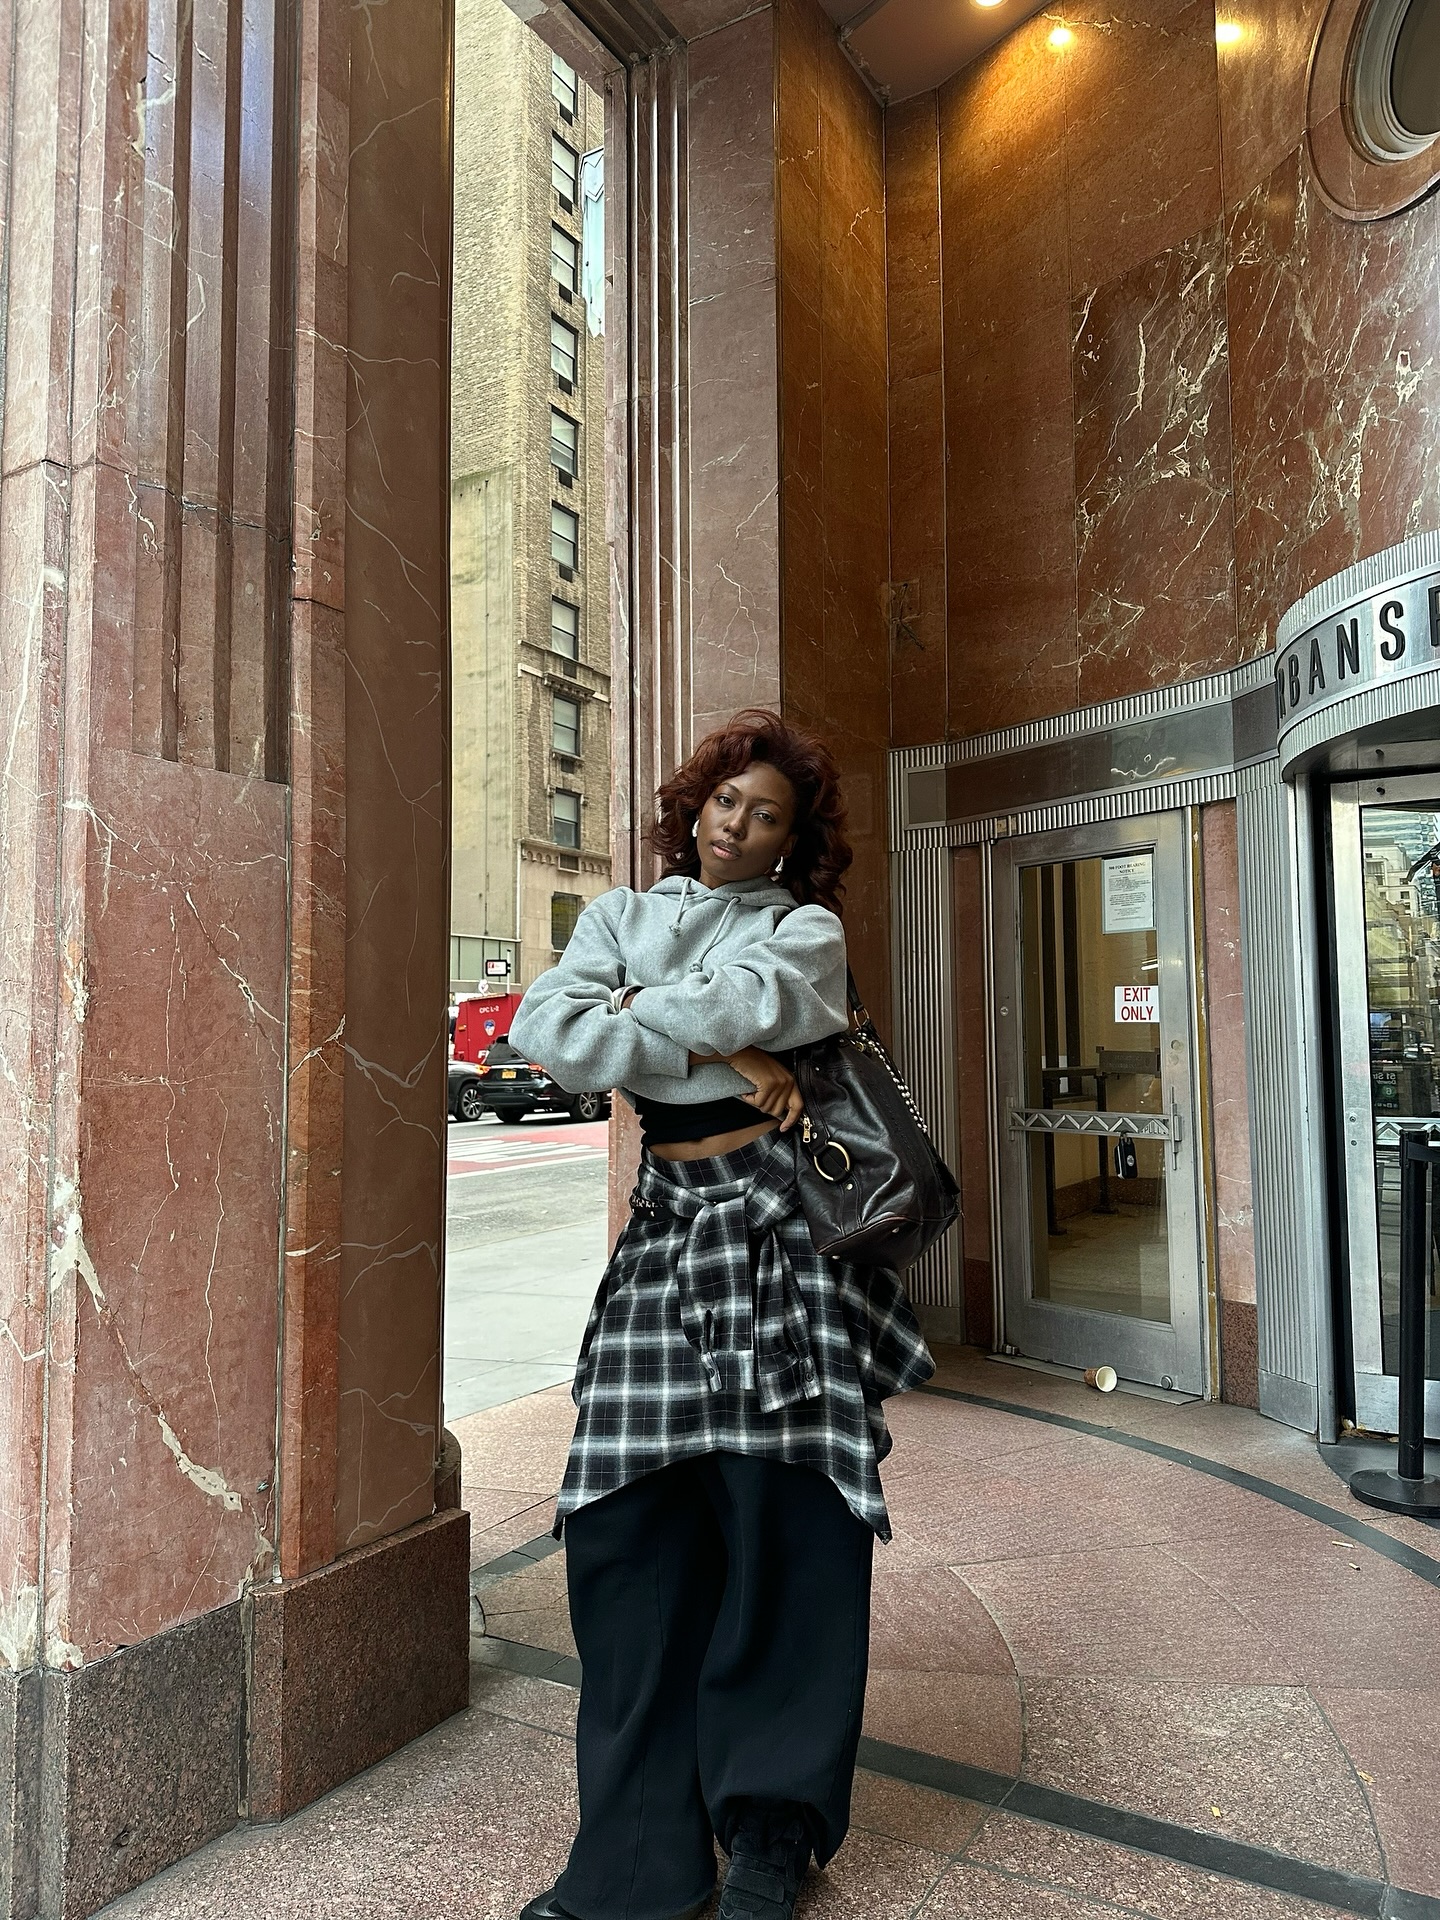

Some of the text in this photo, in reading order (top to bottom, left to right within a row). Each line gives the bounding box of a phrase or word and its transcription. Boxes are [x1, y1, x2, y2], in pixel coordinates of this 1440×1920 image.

[1275, 585, 1440, 729] RBANS
[1124, 987, 1150, 1001] EXIT
[1121, 1006, 1153, 1021] ONLY
